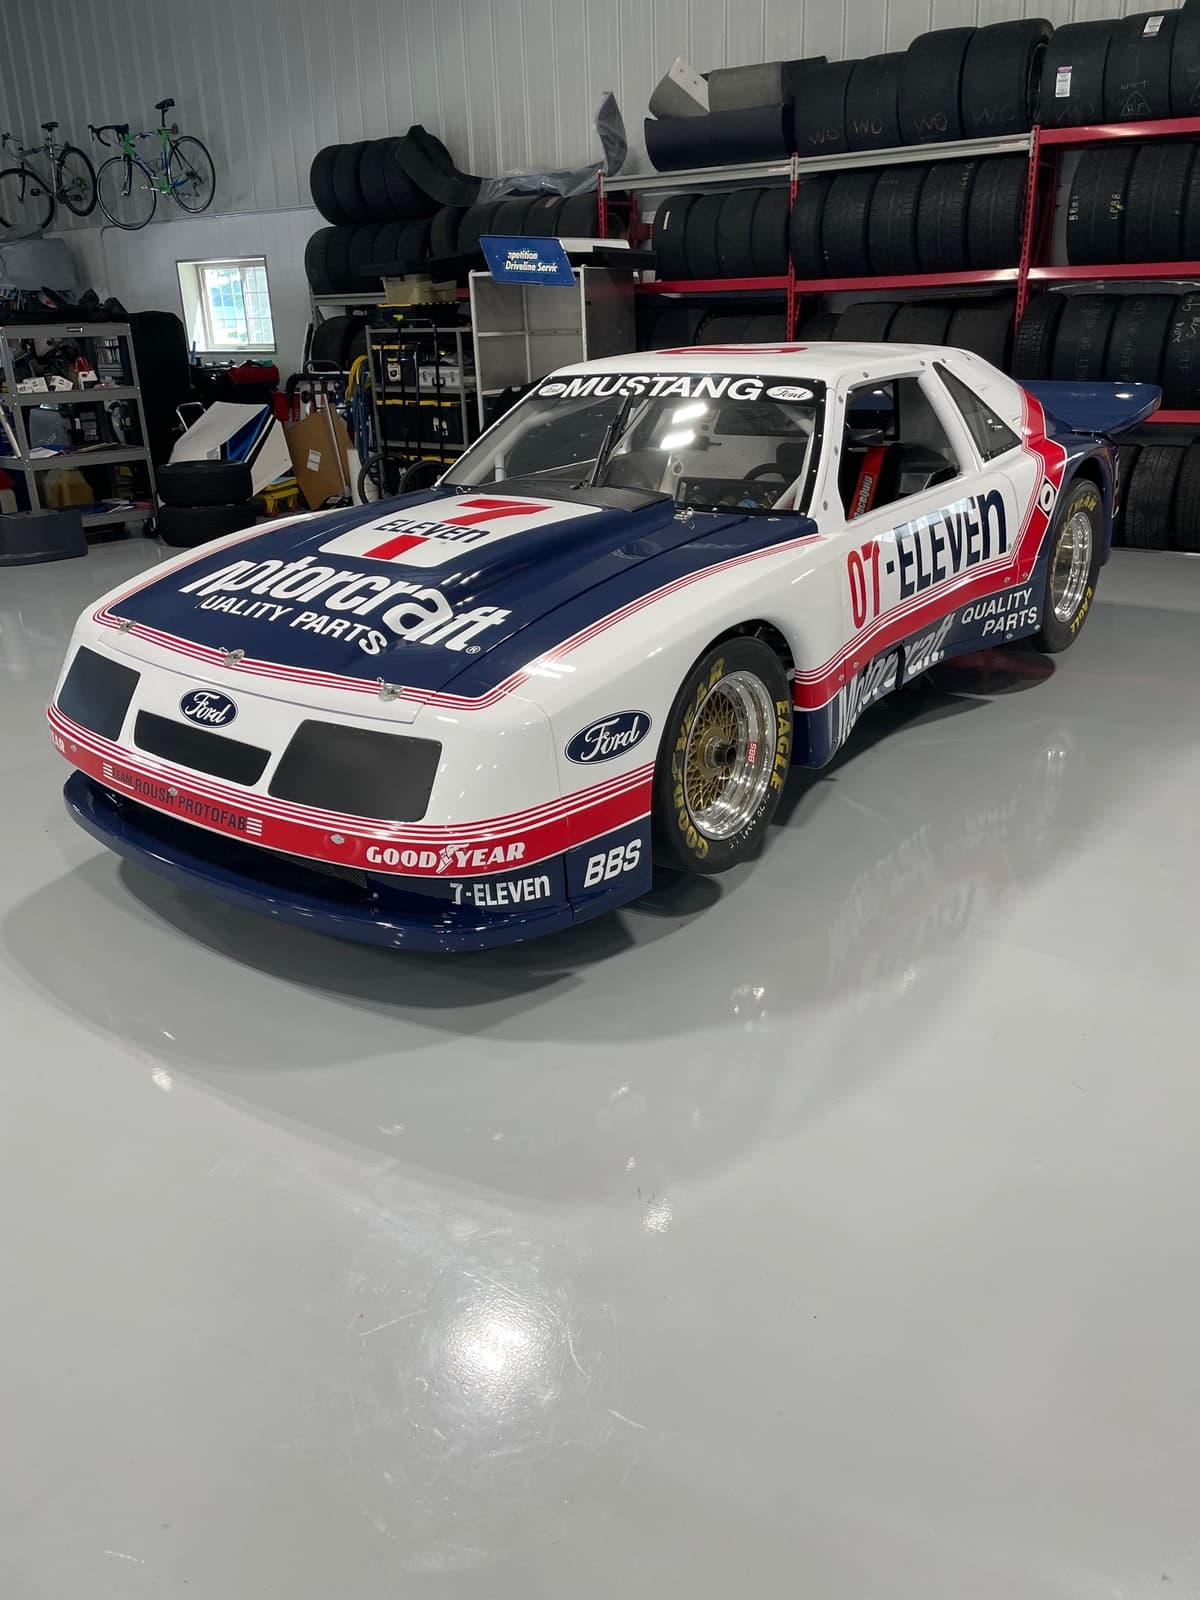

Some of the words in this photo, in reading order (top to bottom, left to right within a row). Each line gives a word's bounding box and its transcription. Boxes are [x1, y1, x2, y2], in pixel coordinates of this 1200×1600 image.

[560, 376, 764, 401] MUSTANG
[961, 587, 1033, 624] QUALITY
[982, 606, 1038, 637] PARTS
[195, 594, 295, 622] UALITY
[289, 610, 388, 655] PARTS
[184, 691, 233, 723] Ford
[579, 715, 641, 761] Ford
[747, 742, 758, 764] BBS
[769, 699, 791, 794] EAGLE
[112, 767, 134, 785] TEAM
[134, 778, 174, 805] ROUSH
[177, 795, 248, 831] PROTOFAB
[366, 841, 526, 869] GOODYEAR
[584, 838, 642, 888] BBS
